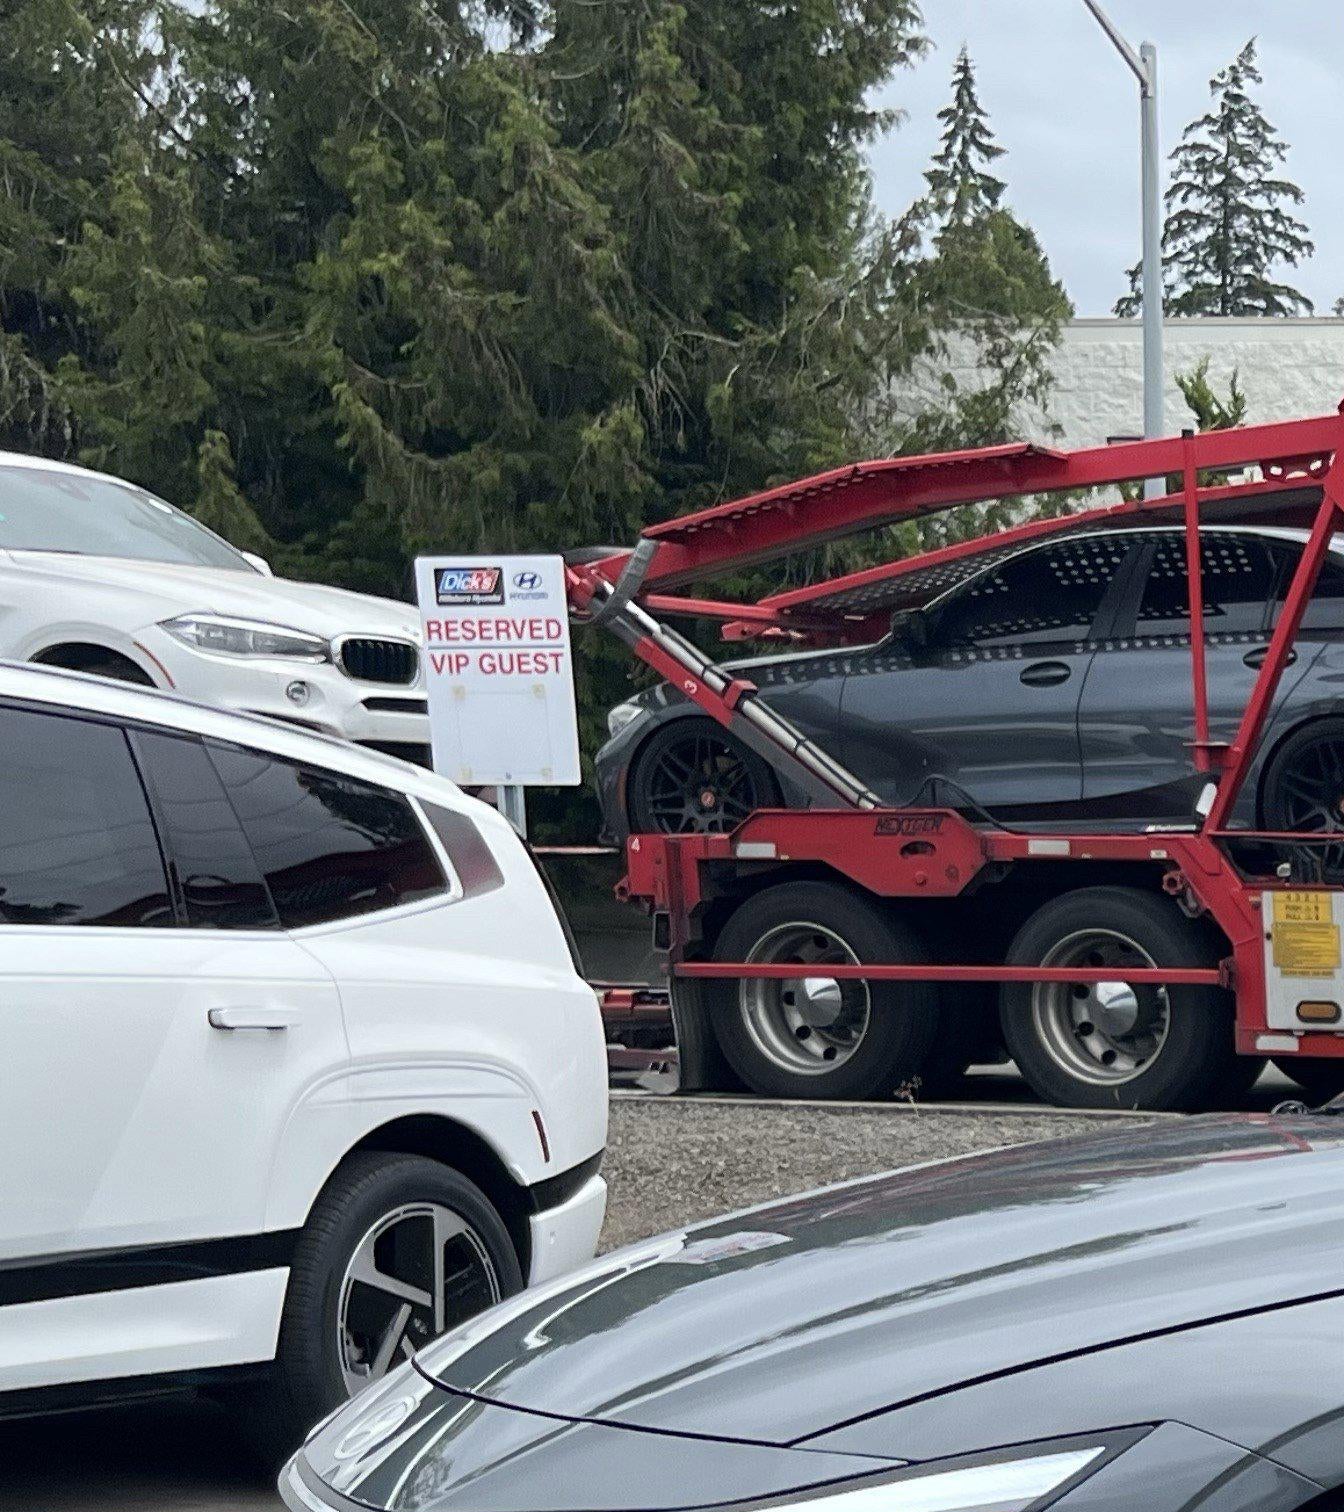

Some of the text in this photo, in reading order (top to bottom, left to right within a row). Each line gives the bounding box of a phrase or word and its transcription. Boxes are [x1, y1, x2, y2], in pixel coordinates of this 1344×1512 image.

[426, 618, 563, 641] RESERVED
[429, 652, 564, 675] VIP GUEST
